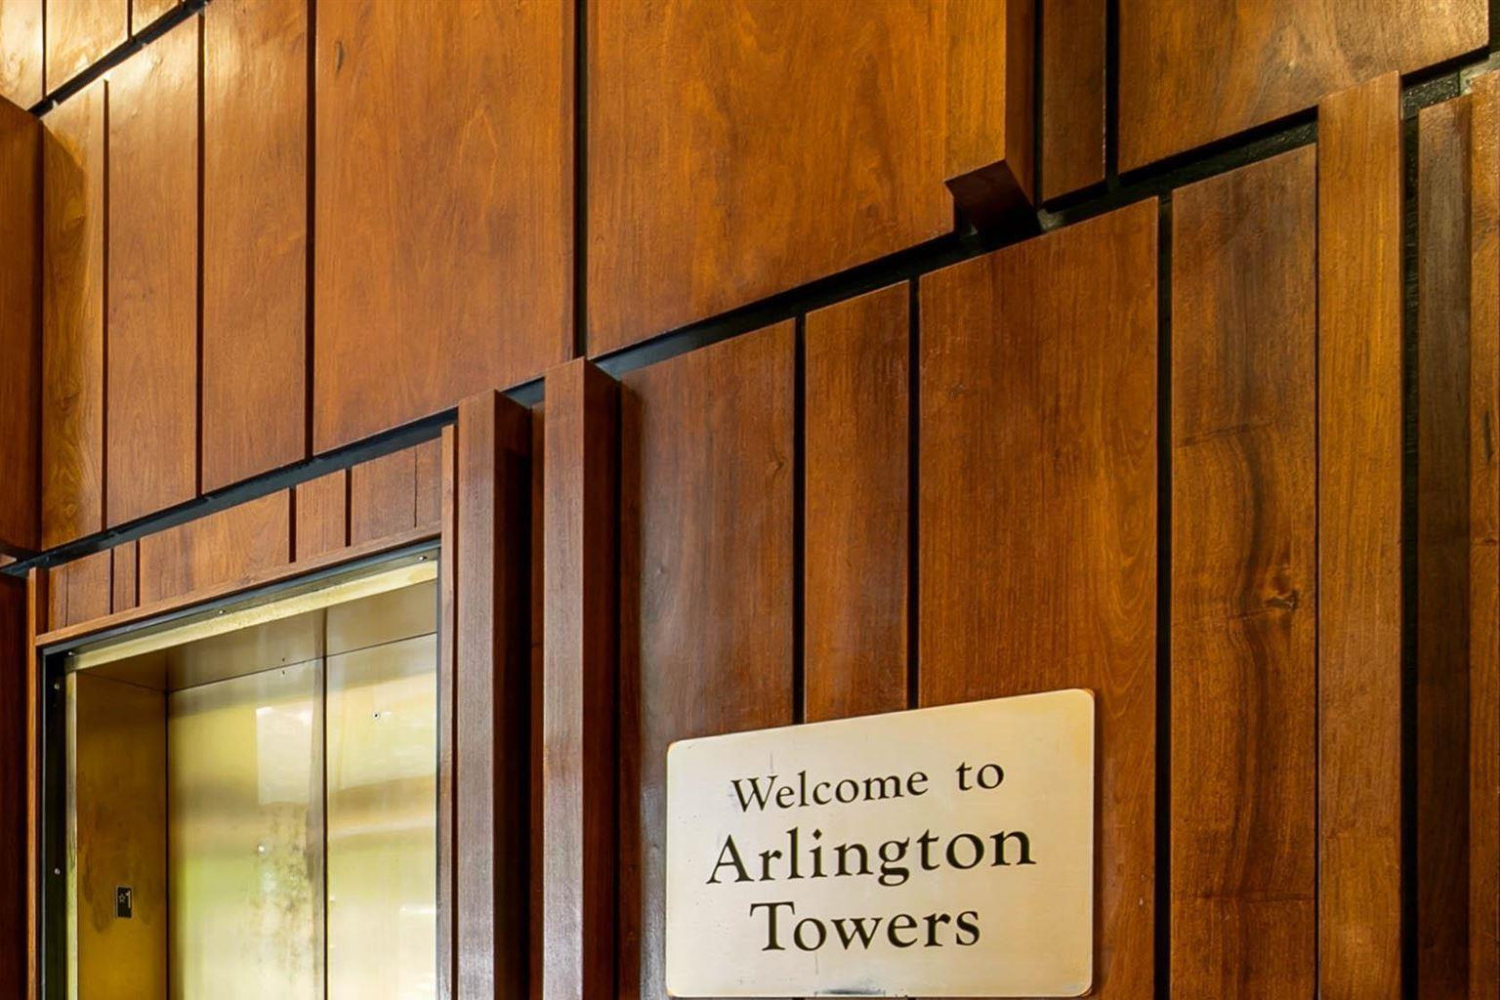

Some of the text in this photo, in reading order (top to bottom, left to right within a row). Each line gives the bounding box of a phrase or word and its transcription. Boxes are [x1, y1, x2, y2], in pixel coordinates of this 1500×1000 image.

[731, 762, 1005, 812] Welcome to
[706, 826, 1037, 887] Arlington
[749, 901, 981, 952] Towers
